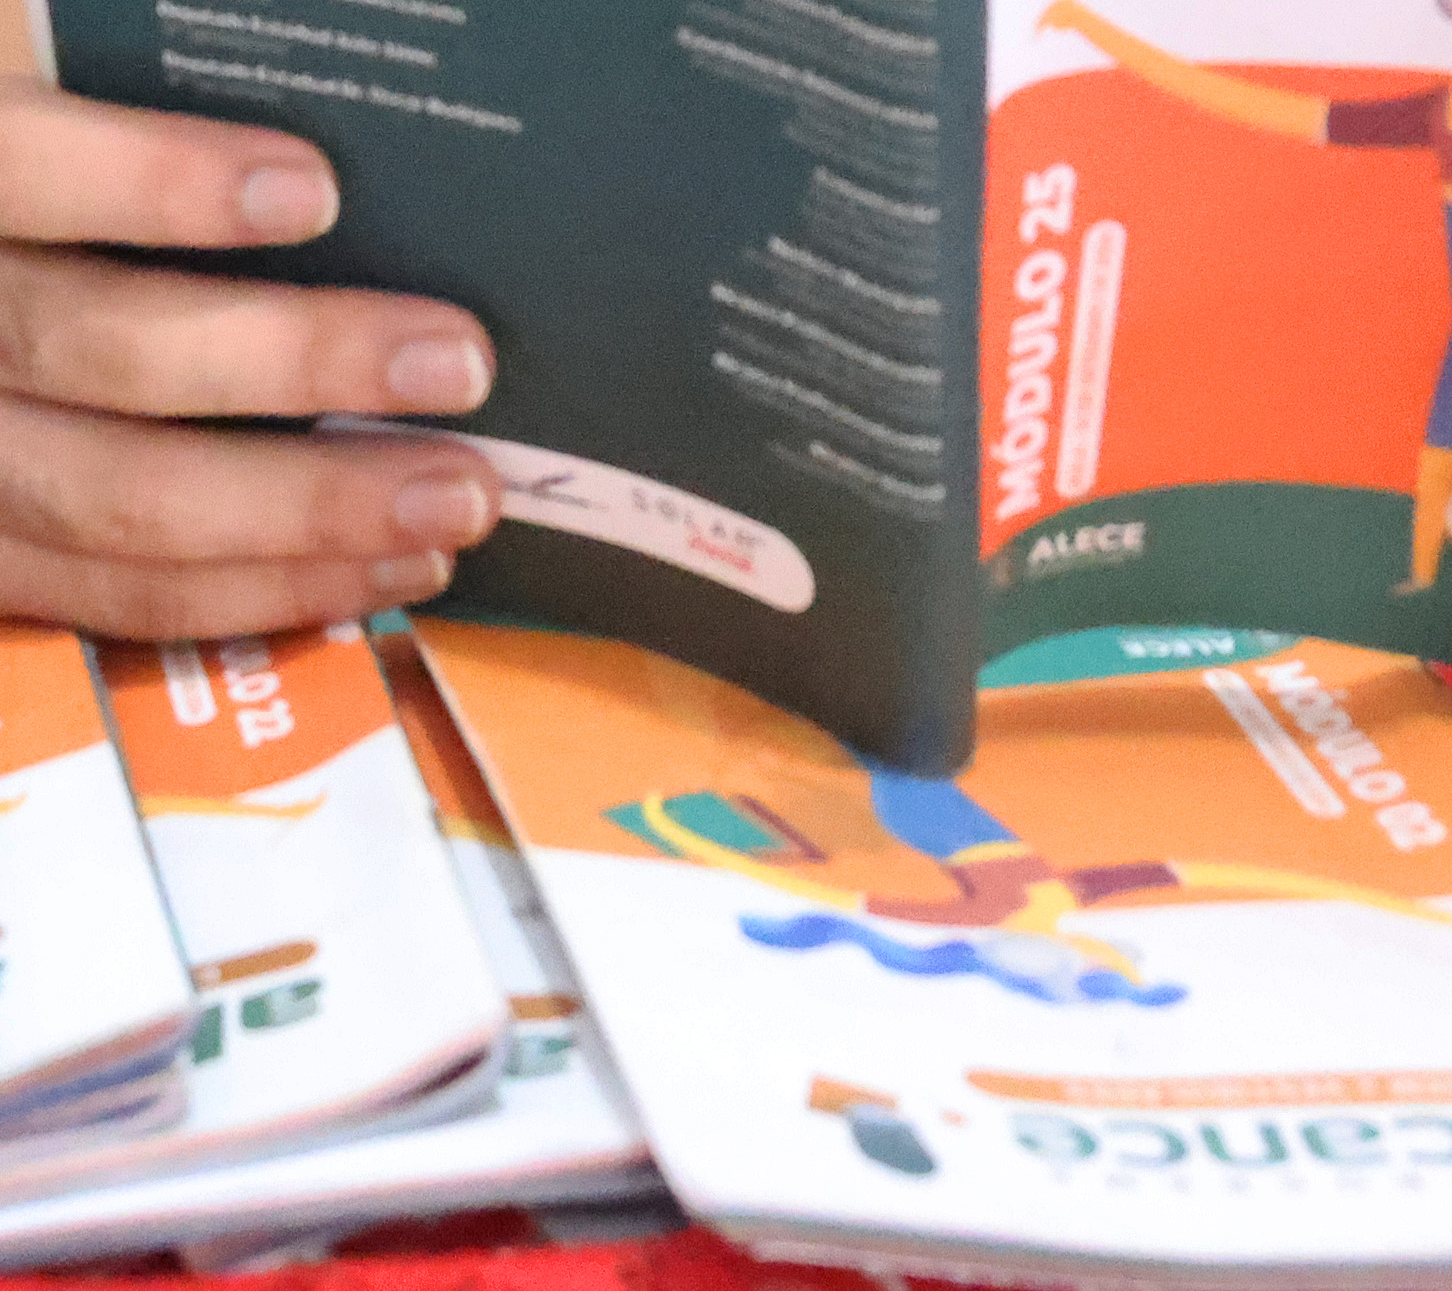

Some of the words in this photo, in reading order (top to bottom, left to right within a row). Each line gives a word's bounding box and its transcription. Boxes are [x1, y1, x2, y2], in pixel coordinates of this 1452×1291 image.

[1019, 161, 1078, 245] 25
[990, 250, 1069, 522] MÓDULO
[1026, 521, 1147, 566] ALECE
[234, 697, 296, 750] 22
